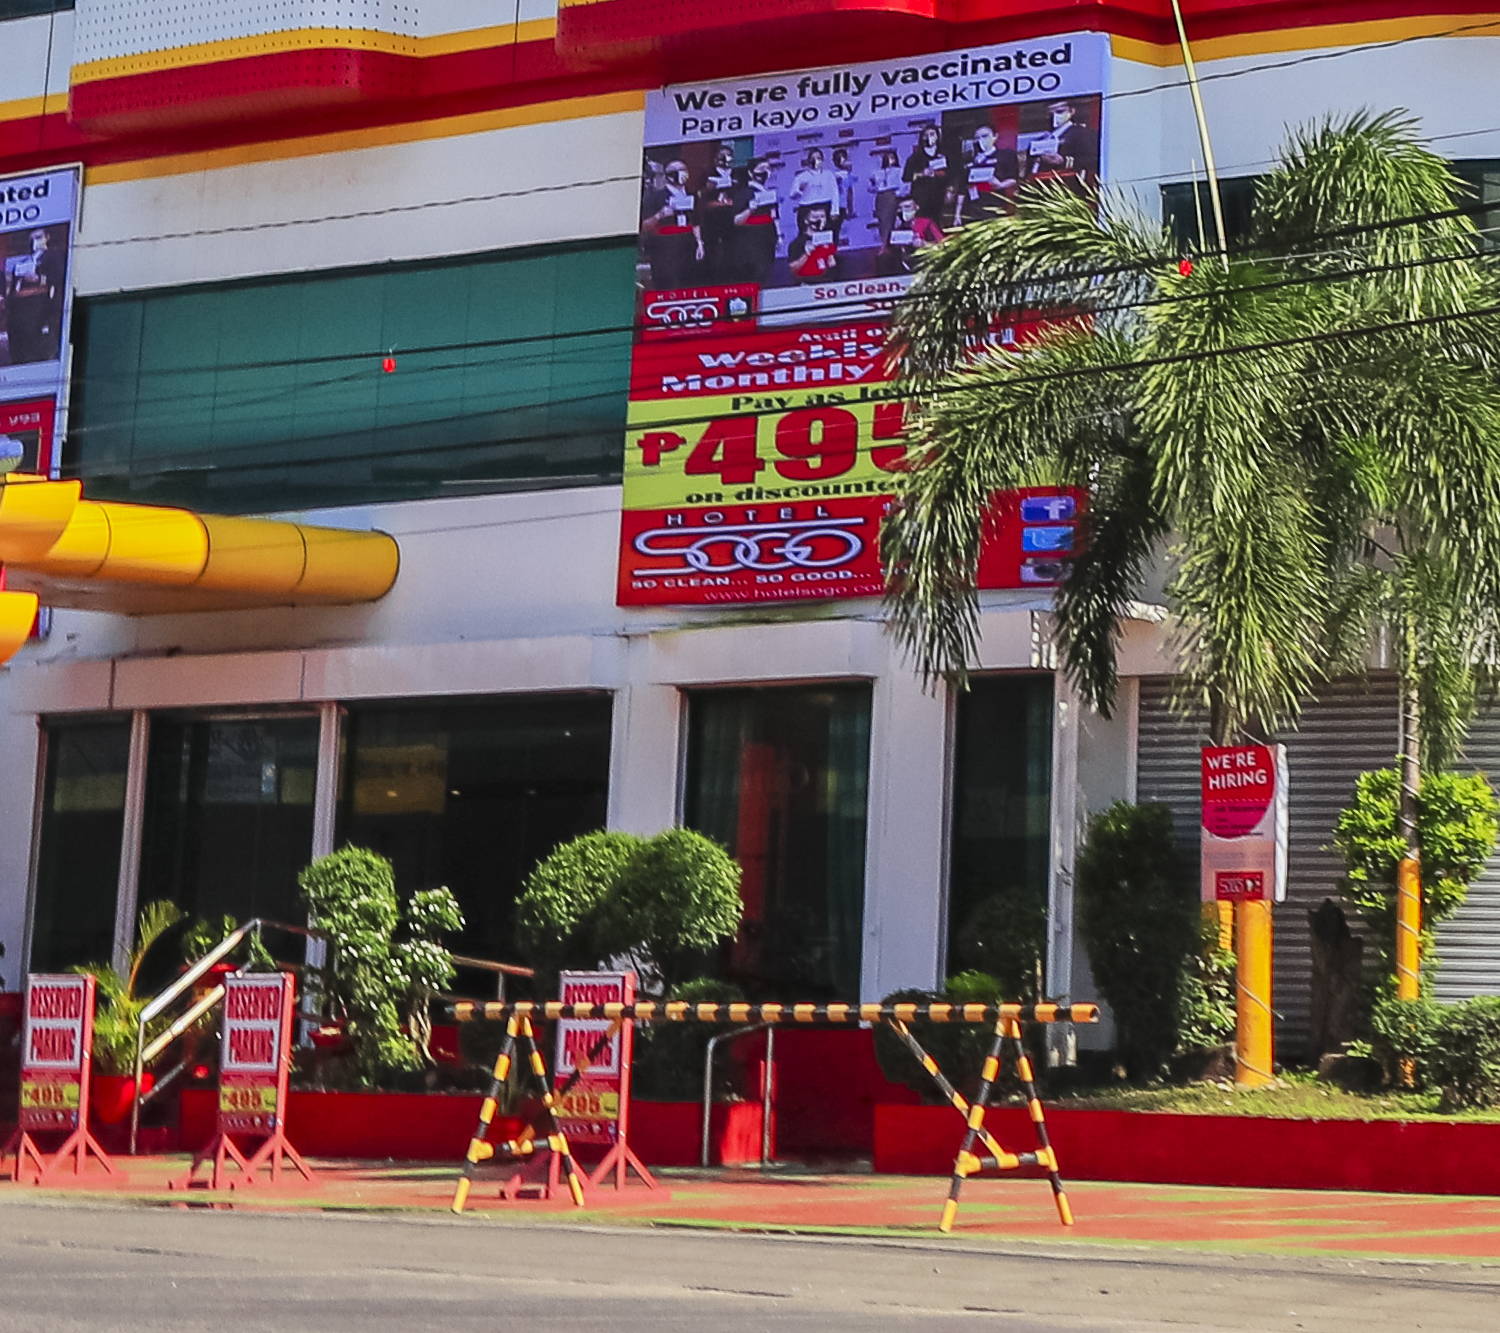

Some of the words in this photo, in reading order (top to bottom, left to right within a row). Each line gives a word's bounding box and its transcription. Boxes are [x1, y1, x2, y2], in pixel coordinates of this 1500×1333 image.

[674, 90, 726, 112] We
[736, 83, 788, 107] are
[798, 69, 872, 102] fully
[880, 42, 1072, 89] vaccinated
[681, 112, 743, 136] Para
[751, 104, 819, 133] kayo
[827, 100, 861, 121] ay
[870, 71, 1062, 114] ProtekTODO
[814, 286, 839, 300] So
[699, 342, 884, 369] Weekly
[661, 363, 875, 393] Monthly
[731, 394, 793, 412] Pay
[686, 490, 723, 505] on
[668, 505, 829, 526] HOTEL
[633, 518, 865, 577] SOGO
[756, 573, 784, 584] SO
[1206, 751, 1257, 771] WE'RE
[1208, 768, 1268, 792] HIRING
